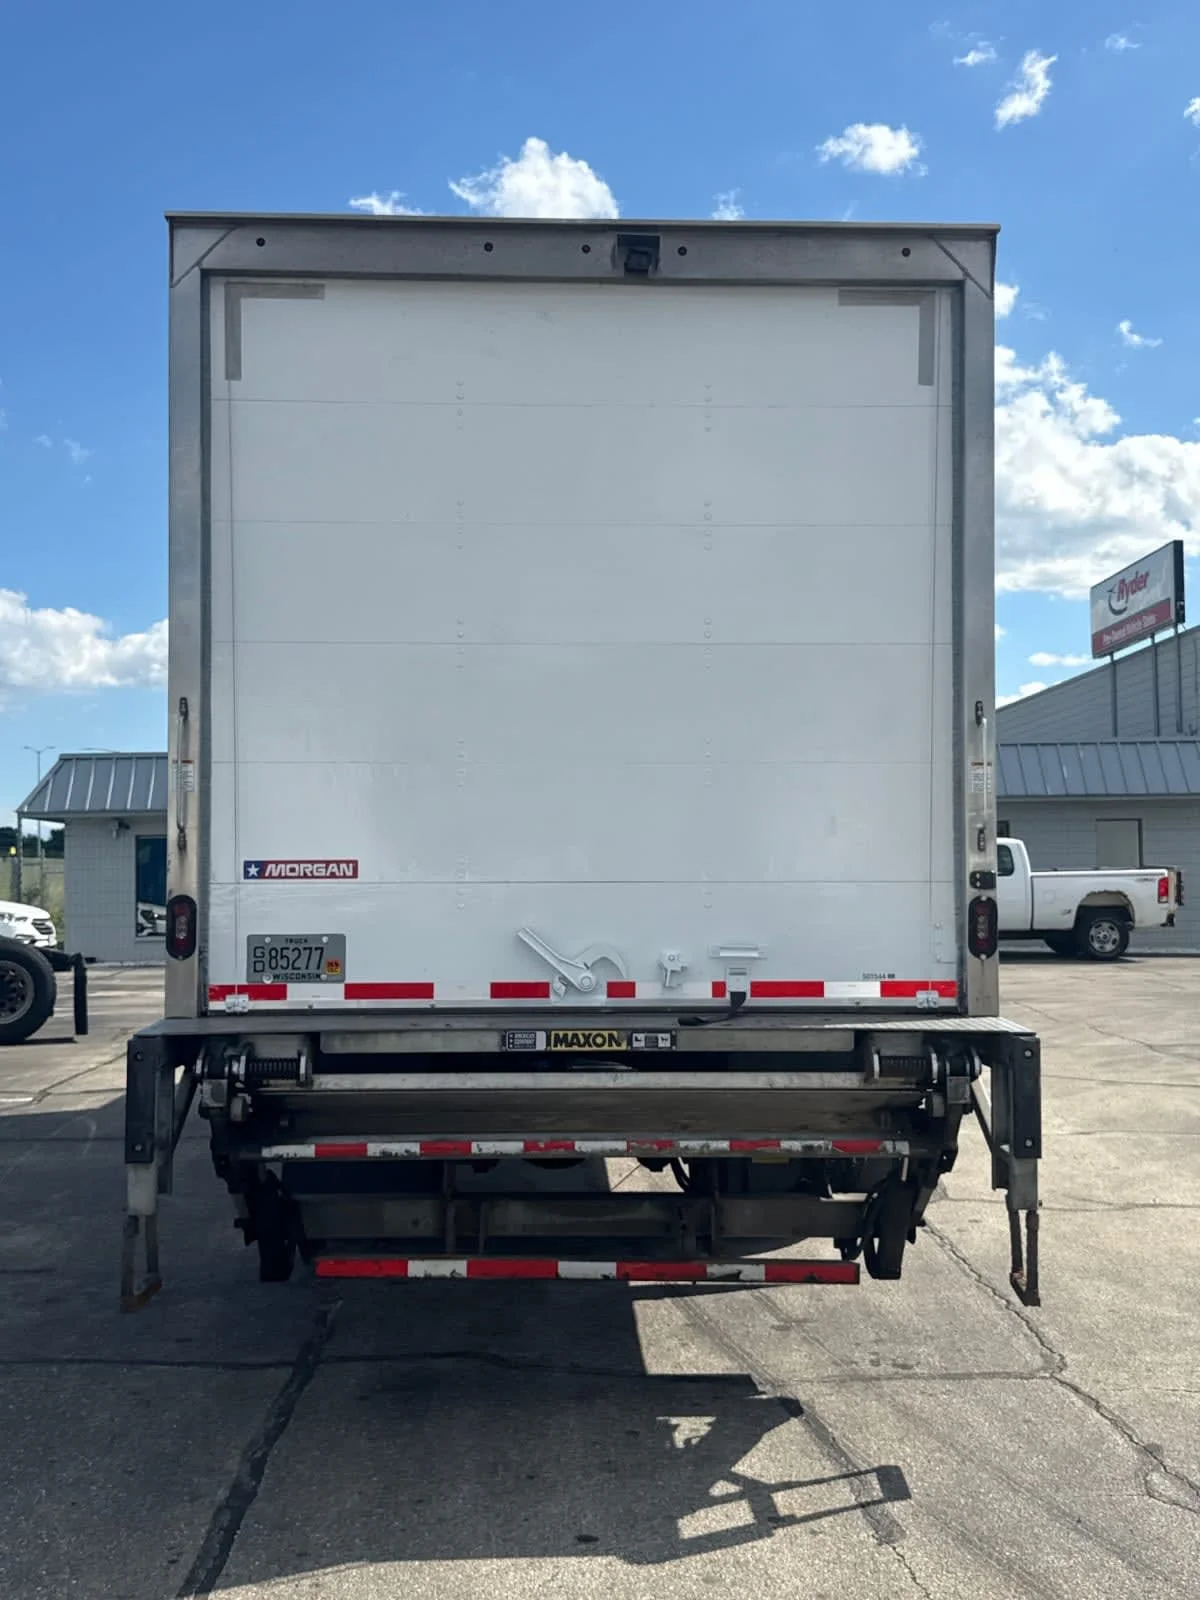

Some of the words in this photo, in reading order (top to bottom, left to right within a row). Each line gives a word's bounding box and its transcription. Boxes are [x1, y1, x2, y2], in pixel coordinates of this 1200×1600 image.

[1117, 571, 1150, 604] Ryder
[264, 863, 354, 877] MORGAN
[268, 946, 325, 971] 85277
[272, 972, 320, 981] WISCONSIN
[553, 1032, 622, 1048] MAXON
